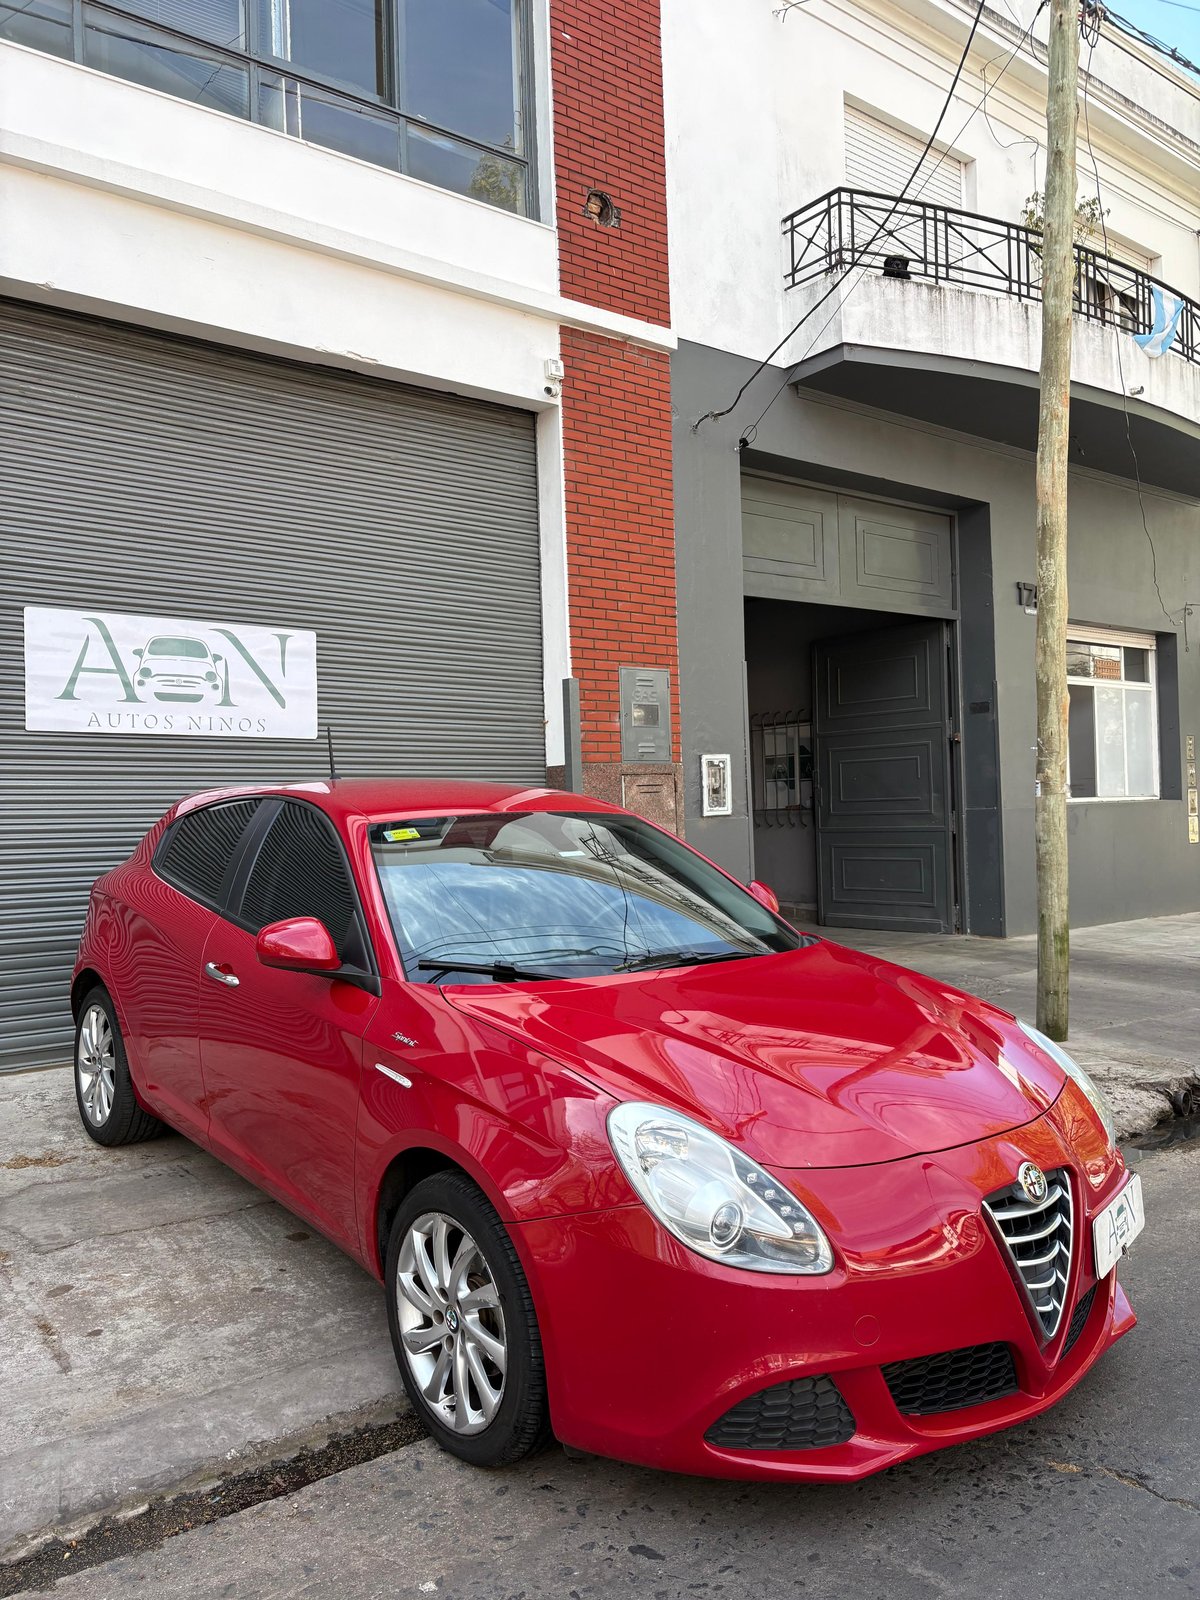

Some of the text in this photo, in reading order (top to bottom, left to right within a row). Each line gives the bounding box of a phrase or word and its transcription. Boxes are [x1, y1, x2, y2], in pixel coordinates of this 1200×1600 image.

[1016, 581, 1037, 608] 17
[87, 712, 267, 733] AUTOS NINOS
